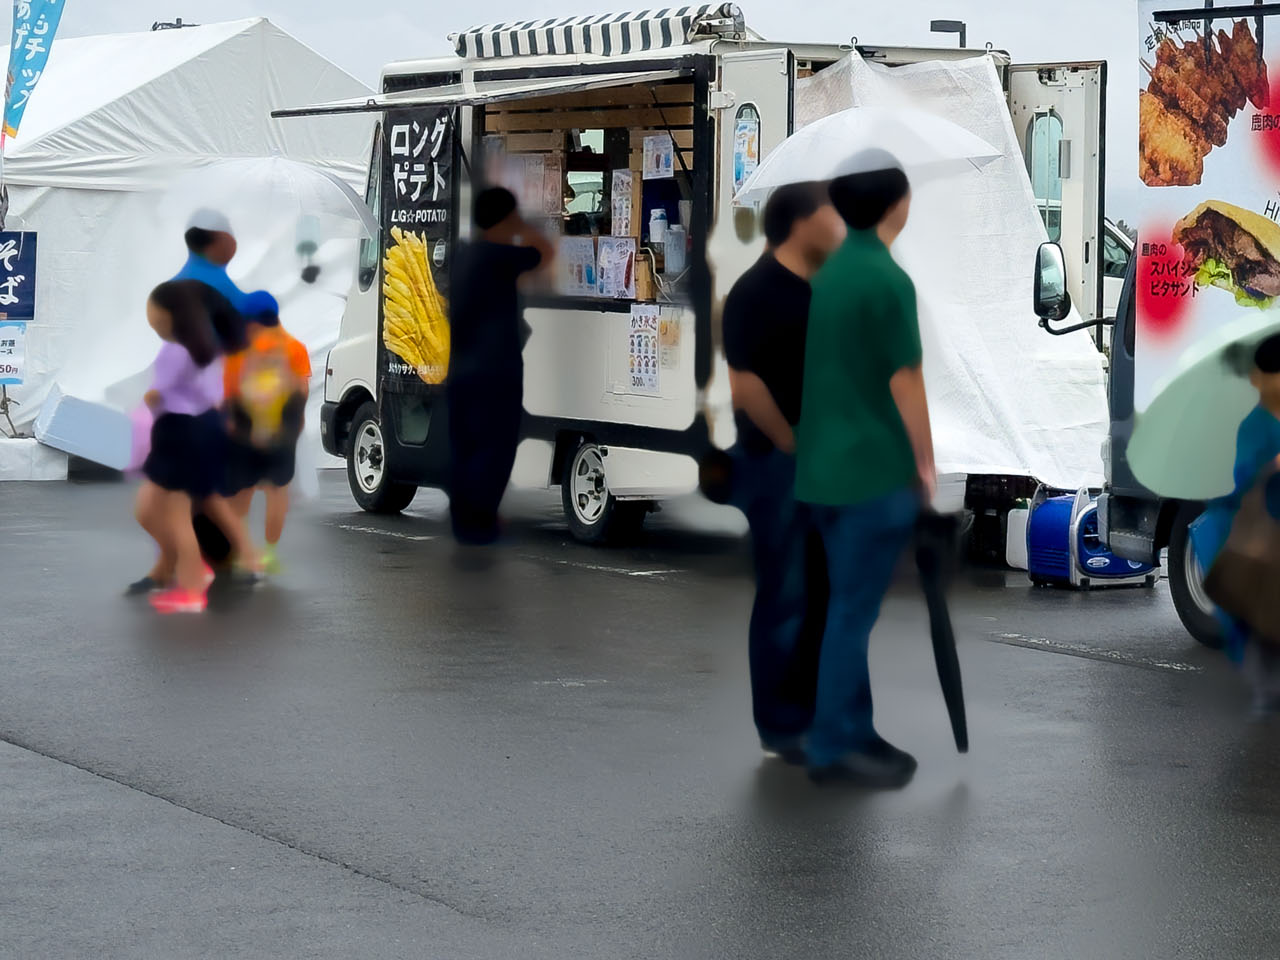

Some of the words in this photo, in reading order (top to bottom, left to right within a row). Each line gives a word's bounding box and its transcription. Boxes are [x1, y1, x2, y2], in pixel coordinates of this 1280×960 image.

[391, 116, 447, 159] ロング
[393, 161, 446, 202] ポテト
